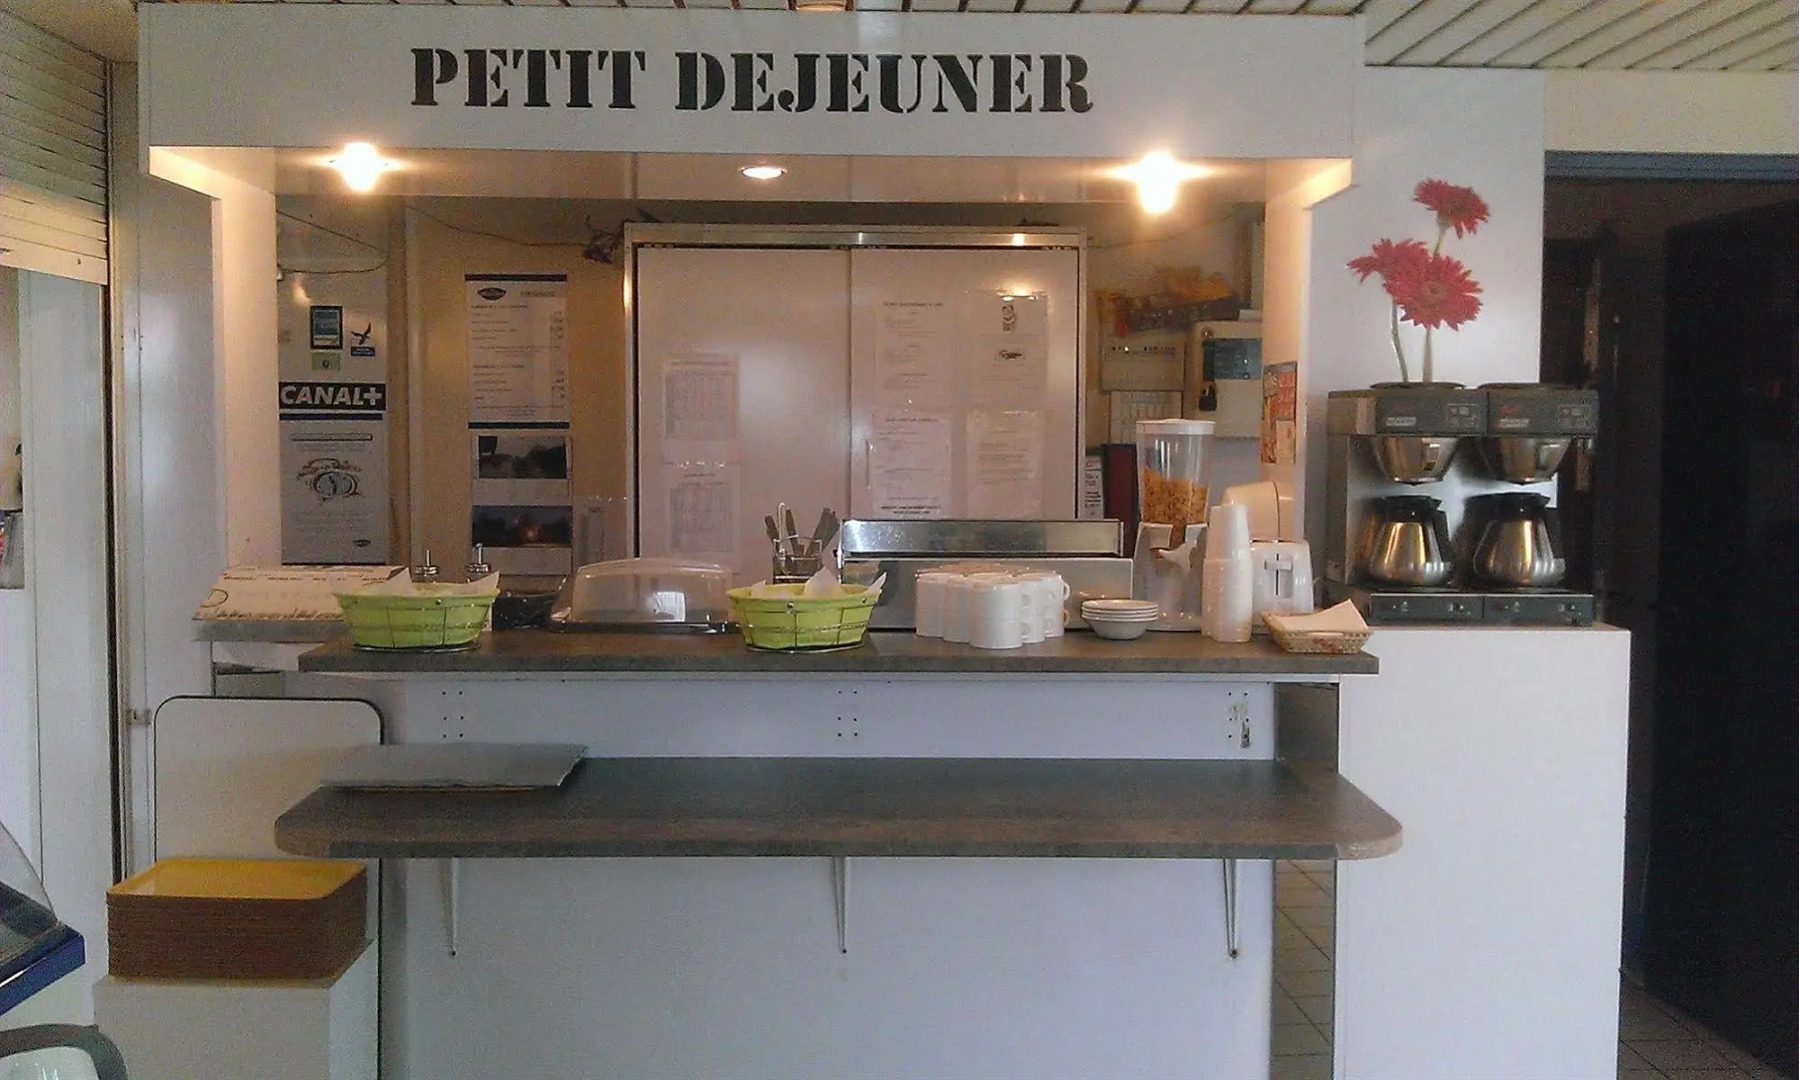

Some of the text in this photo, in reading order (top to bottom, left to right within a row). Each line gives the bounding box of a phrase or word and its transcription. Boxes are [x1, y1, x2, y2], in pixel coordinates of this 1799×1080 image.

[411, 48, 1094, 114] PETIT DEJEUNER
[281, 386, 382, 405] CANAL+
